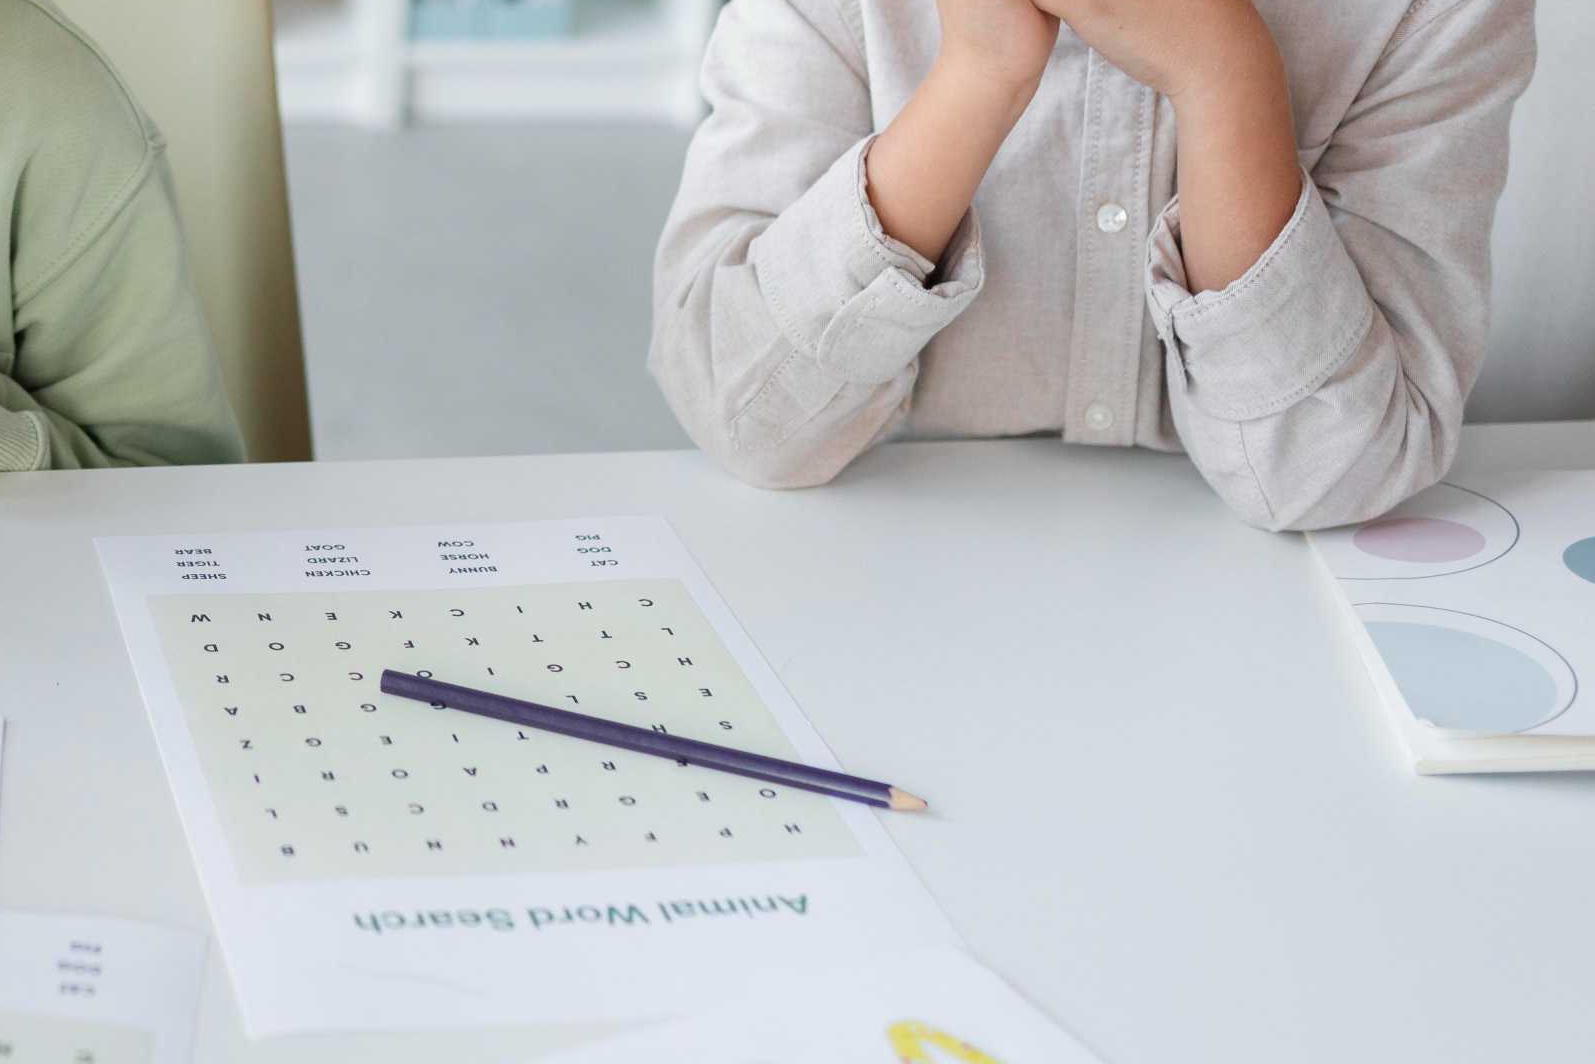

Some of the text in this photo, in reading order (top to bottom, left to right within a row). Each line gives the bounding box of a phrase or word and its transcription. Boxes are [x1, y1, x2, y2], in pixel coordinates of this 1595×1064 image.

[574, 533, 602, 542] PIG
[304, 543, 346, 552] GOAT
[437, 540, 475, 548] COW
[576, 545, 613, 555] DOG
[174, 547, 213, 556] BEAR
[439, 552, 490, 562] HORSE
[175, 560, 221, 568] TIGER
[306, 555, 359, 565] LIZARD
[590, 558, 619, 568] CAT
[304, 568, 372, 578] CHICKEN
[448, 565, 499, 575] BUNNY
[180, 572, 228, 581] SHEEP
[190, 597, 655, 624] C H I C K E N W
[202, 626, 675, 654] L T T K F G O D
[215, 656, 694, 685] H C G I O C C R
[633, 690, 649, 702] S
[697, 687, 714, 698] E
[565, 694, 580, 705] L
[223, 705, 239, 717] A
[292, 704, 308, 715] B
[359, 702, 378, 714] G
[717, 720, 734, 731] S
[304, 736, 323, 748] G
[379, 735, 394, 746] E
[451, 732, 460, 744] I
[516, 730, 530, 742] T
[239, 738, 254, 751] Z
[462, 766, 478, 778] A
[535, 763, 550, 775] P
[600, 760, 617, 772] R
[253, 773, 261, 785] I
[320, 770, 336, 782] R
[390, 768, 410, 780] O
[265, 787, 778, 820] O E G R D C S L
[718, 826, 734, 838] P
[783, 823, 802, 835] H
[575, 834, 588, 846] Y
[353, 841, 370, 854] U
[354, 894, 808, 934] Animal Word Search
